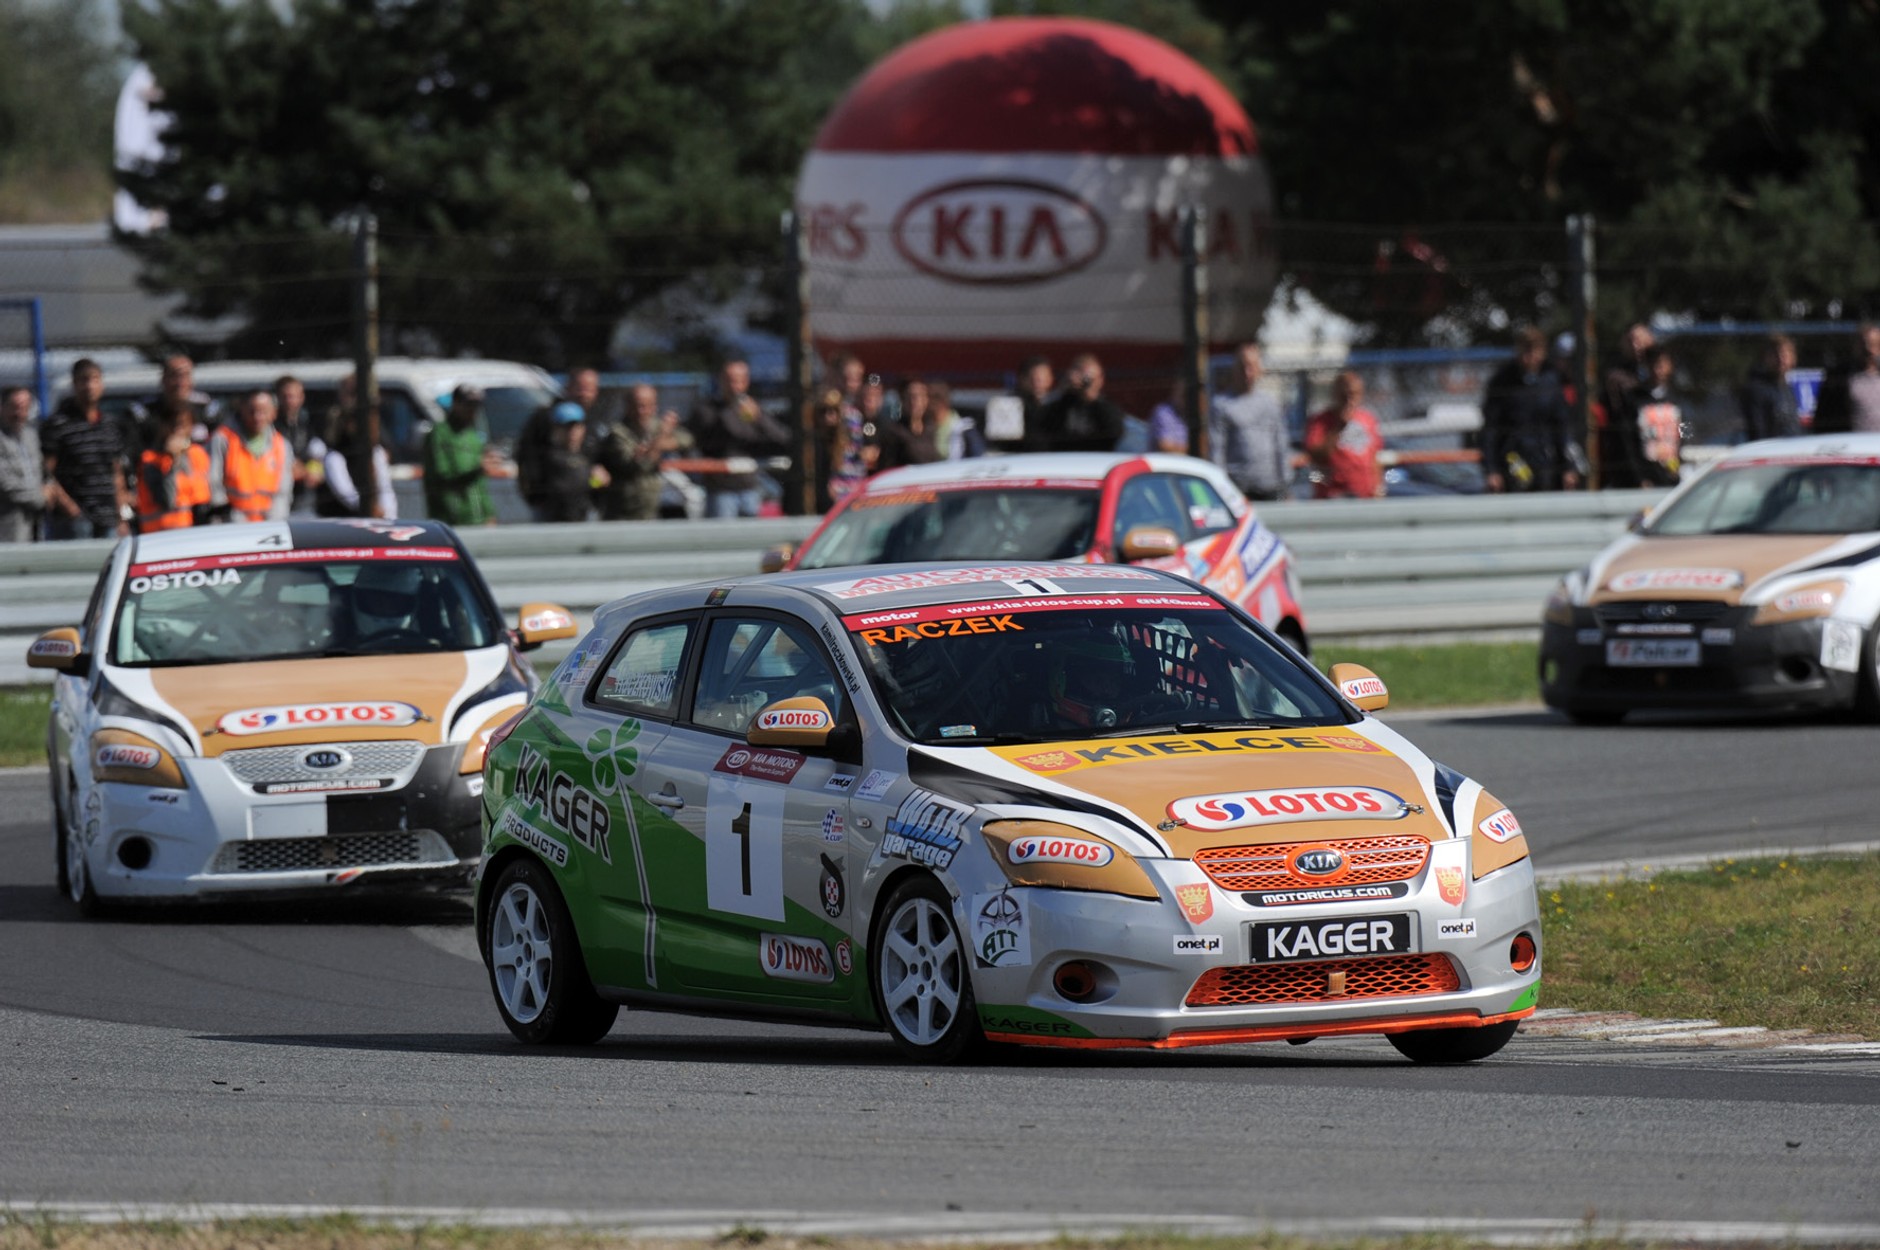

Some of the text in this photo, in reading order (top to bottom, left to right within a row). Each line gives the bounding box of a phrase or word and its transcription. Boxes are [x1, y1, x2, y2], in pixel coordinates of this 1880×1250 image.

[931, 205, 1070, 261] KIA
[1147, 207, 1243, 262] KA
[257, 534, 287, 546] 4
[130, 567, 242, 594] OSTOJA
[1017, 579, 1050, 594] 1
[861, 610, 919, 625] motor
[946, 598, 1124, 615] www.kia-lotos-cup.pl
[860, 614, 1025, 647] RACZEK
[821, 622, 861, 695] kamilraczkowski.pl
[1358, 680, 1383, 694] LOTOS
[287, 705, 396, 724] LOTOS
[779, 713, 819, 726] LOTOS
[111, 749, 151, 765] LOTOS
[730, 752, 748, 765] KIA
[1073, 736, 1331, 763] KIELCE
[752, 753, 798, 769] KIA MOTORS
[829, 777, 852, 788] onet.pl
[515, 744, 609, 860] KAGER
[1246, 791, 1383, 817] LOTOS
[505, 815, 566, 863] PRODUCTS
[829, 834, 843, 842] CUP
[732, 802, 752, 896] 1
[882, 833, 953, 868] garage
[1038, 840, 1101, 861] LOTOS
[1303, 851, 1339, 869] KIA
[1446, 888, 1461, 897] CK
[1188, 905, 1206, 916] CK
[1441, 921, 1474, 935] onet.pl
[1177, 938, 1219, 950] onet.pl
[1267, 920, 1395, 958] KAGER
[783, 941, 827, 975] LOTOS
[839, 947, 849, 969] E
[983, 1016, 1071, 1033] KAGER
